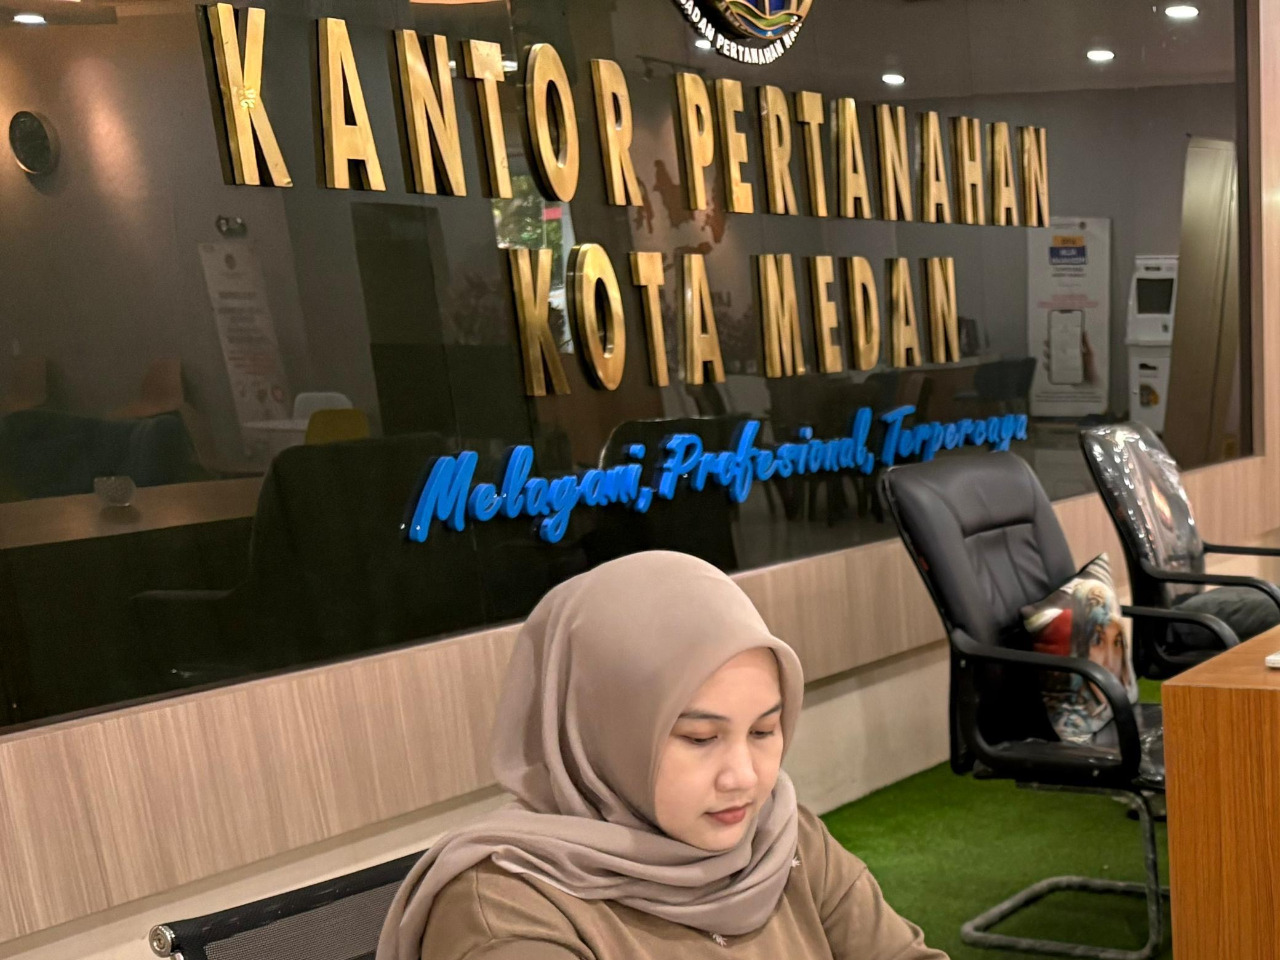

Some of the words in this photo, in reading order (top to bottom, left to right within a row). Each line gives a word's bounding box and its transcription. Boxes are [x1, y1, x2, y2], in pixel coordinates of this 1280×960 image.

[207, 2, 643, 207] KANTOR
[676, 72, 1050, 228] PERTANAHAN
[716, 33, 784, 65] PERTANAHAN
[508, 243, 726, 397] KOTA
[757, 253, 960, 378] MEDAN
[408, 444, 654, 543] Melayani,
[658, 406, 874, 503] Profesional,
[881, 404, 1028, 467] Terpercaya
